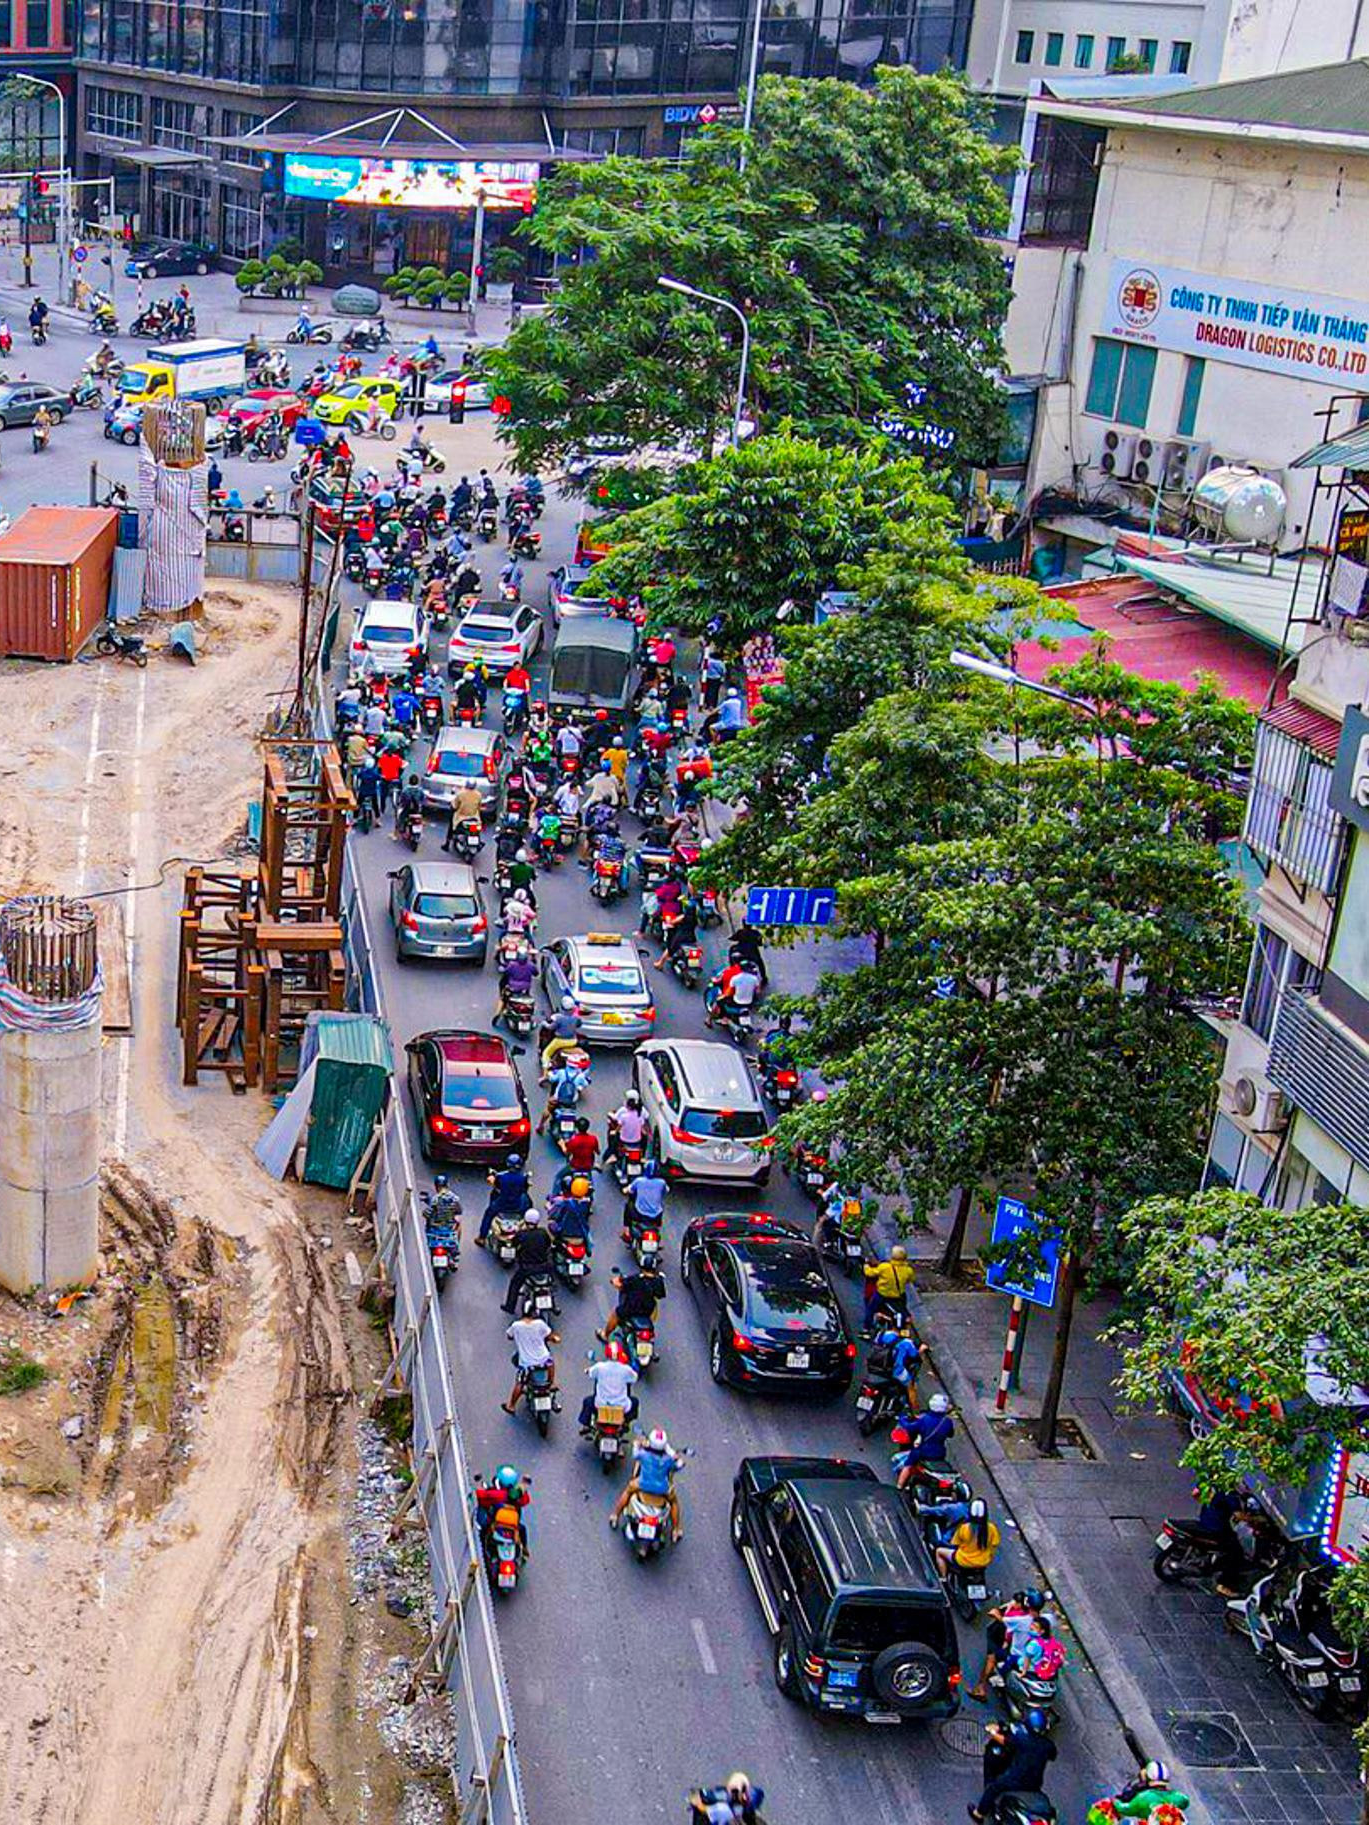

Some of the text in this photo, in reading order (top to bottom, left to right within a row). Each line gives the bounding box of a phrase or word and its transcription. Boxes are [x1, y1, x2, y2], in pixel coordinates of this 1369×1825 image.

[664, 106, 700, 123] BIDV
[1170, 286, 1203, 312] CÔNG
[1208, 295, 1222, 316] TY
[1224, 297, 1258, 322] TNHH
[1261, 301, 1289, 328] TIẾP
[1292, 307, 1320, 337] VẬN
[1196, 322, 1368, 374] DRAGON LOGISTICS CO.,LTD
